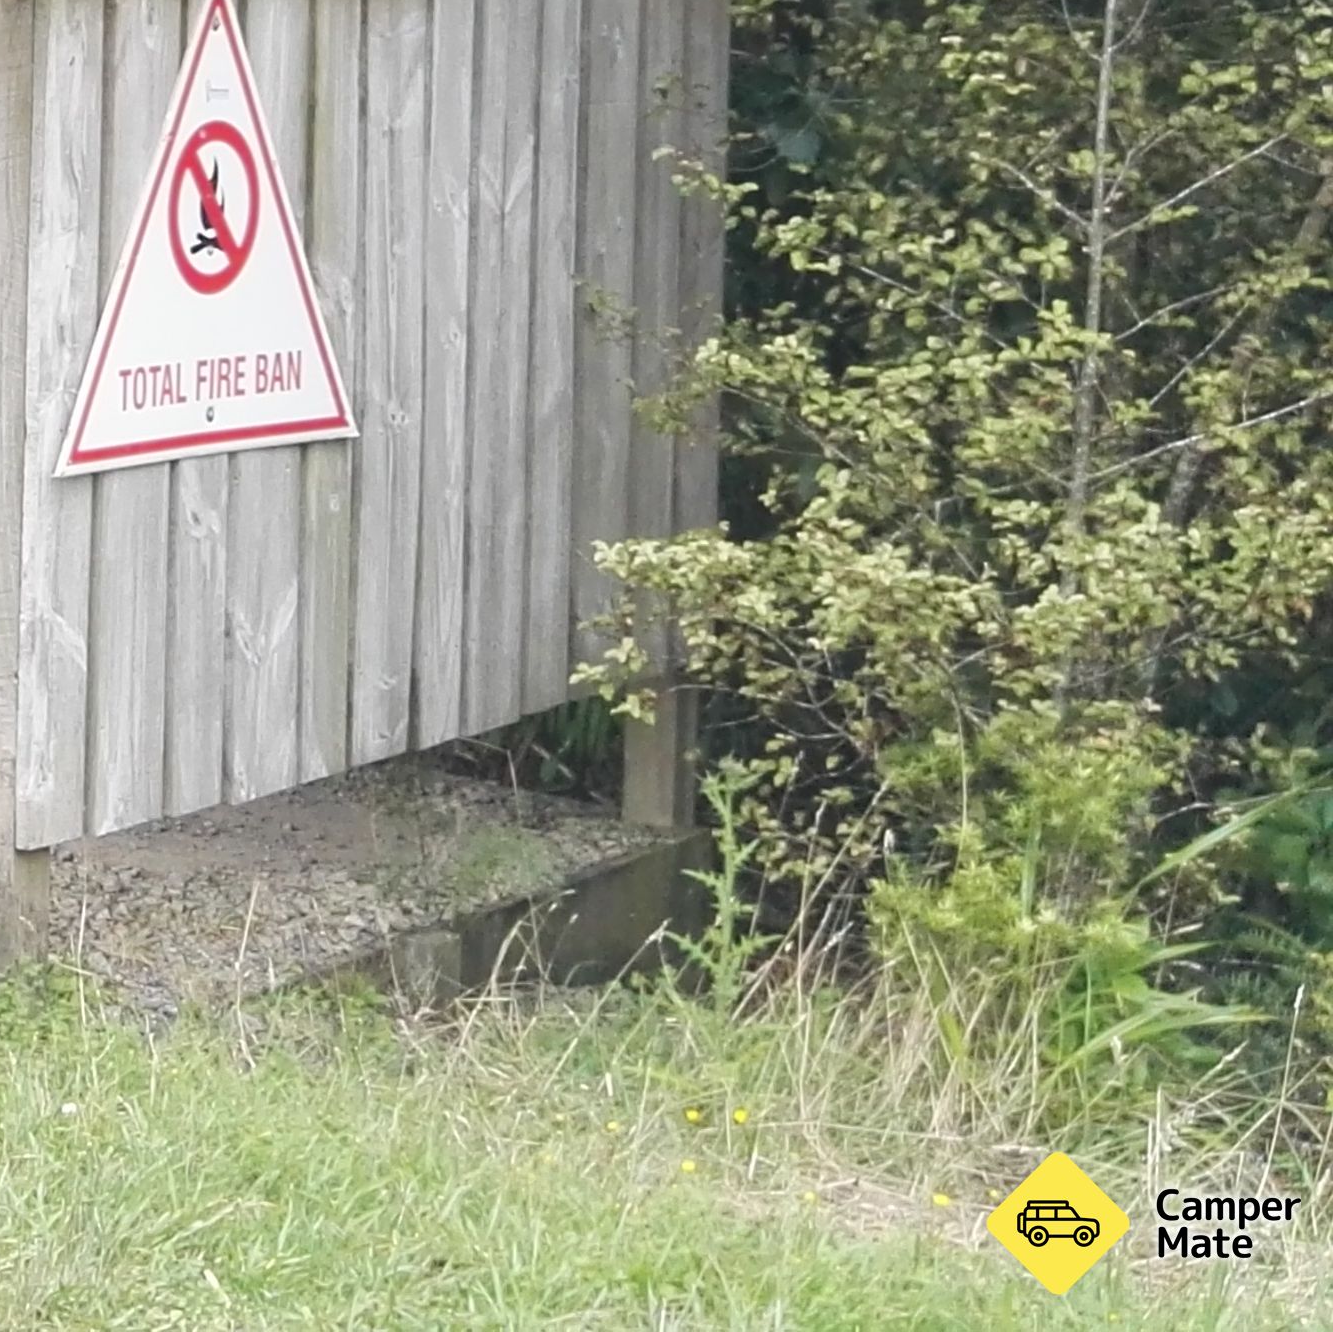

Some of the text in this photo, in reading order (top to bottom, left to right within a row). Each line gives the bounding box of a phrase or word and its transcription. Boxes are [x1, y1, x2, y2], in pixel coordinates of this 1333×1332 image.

[119, 350, 302, 411] TOTAL FIRE BAN
